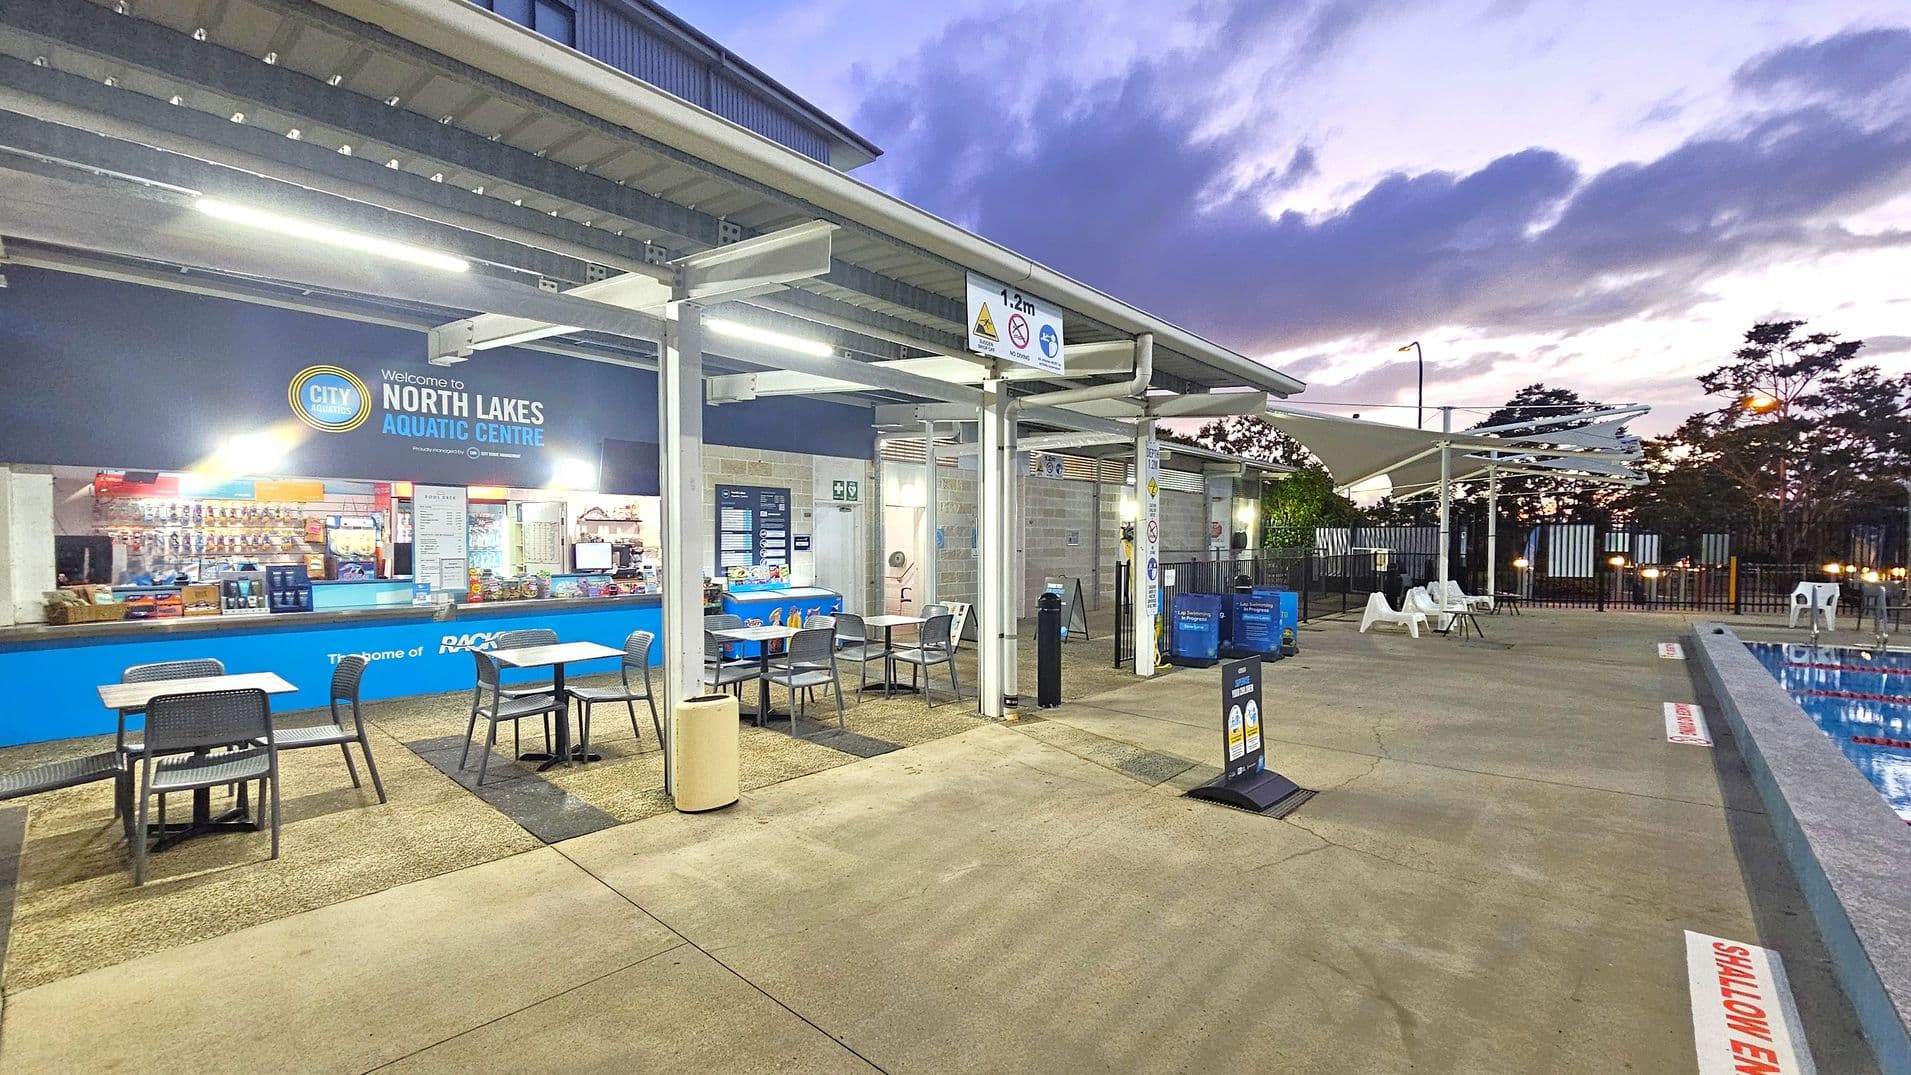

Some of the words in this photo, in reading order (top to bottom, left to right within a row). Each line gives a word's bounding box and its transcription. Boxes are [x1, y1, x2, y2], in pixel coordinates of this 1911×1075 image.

[1001, 289, 1035, 316] 1.2m
[1017, 352, 1031, 361] DIVING
[381, 369, 447, 387] Welcome
[451, 379, 464, 390] to
[309, 384, 351, 405] CITY
[383, 383, 468, 417] NORTH
[476, 394, 544, 425] LAKES
[311, 404, 352, 415] AQUATICS
[382, 413, 469, 441] AQUATIC
[475, 422, 544, 447] CENTRE
[327, 653, 347, 664] Th
[362, 649, 404, 662] home
[408, 646, 424, 657] of
[1712, 942, 1773, 1043] SHALLOW
